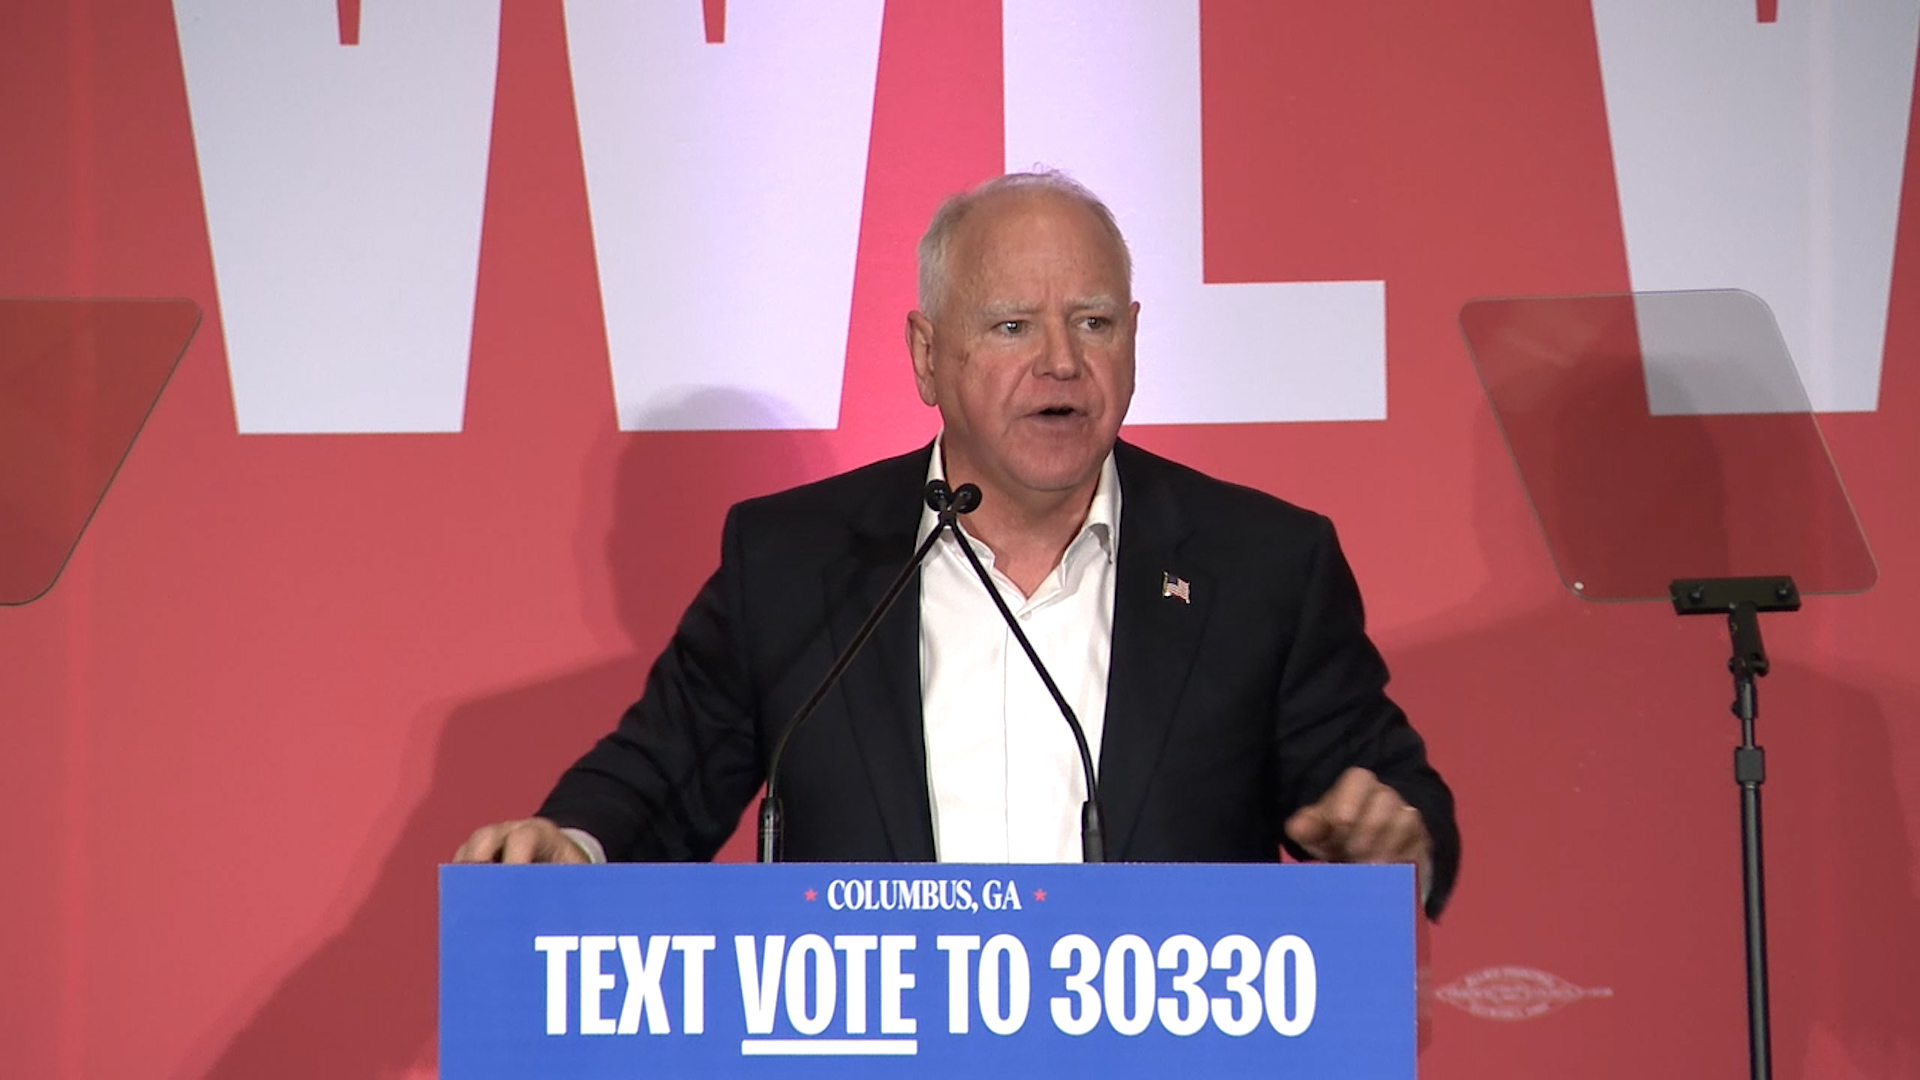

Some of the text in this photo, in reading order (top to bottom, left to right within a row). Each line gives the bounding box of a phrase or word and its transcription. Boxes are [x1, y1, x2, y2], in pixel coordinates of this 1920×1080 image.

[827, 879, 1023, 914] COLUMBUS, GA
[535, 935, 716, 1036] TEXT
[735, 933, 917, 1036] VOTE
[937, 933, 1031, 1036] TO
[1050, 933, 1317, 1037] 30330
